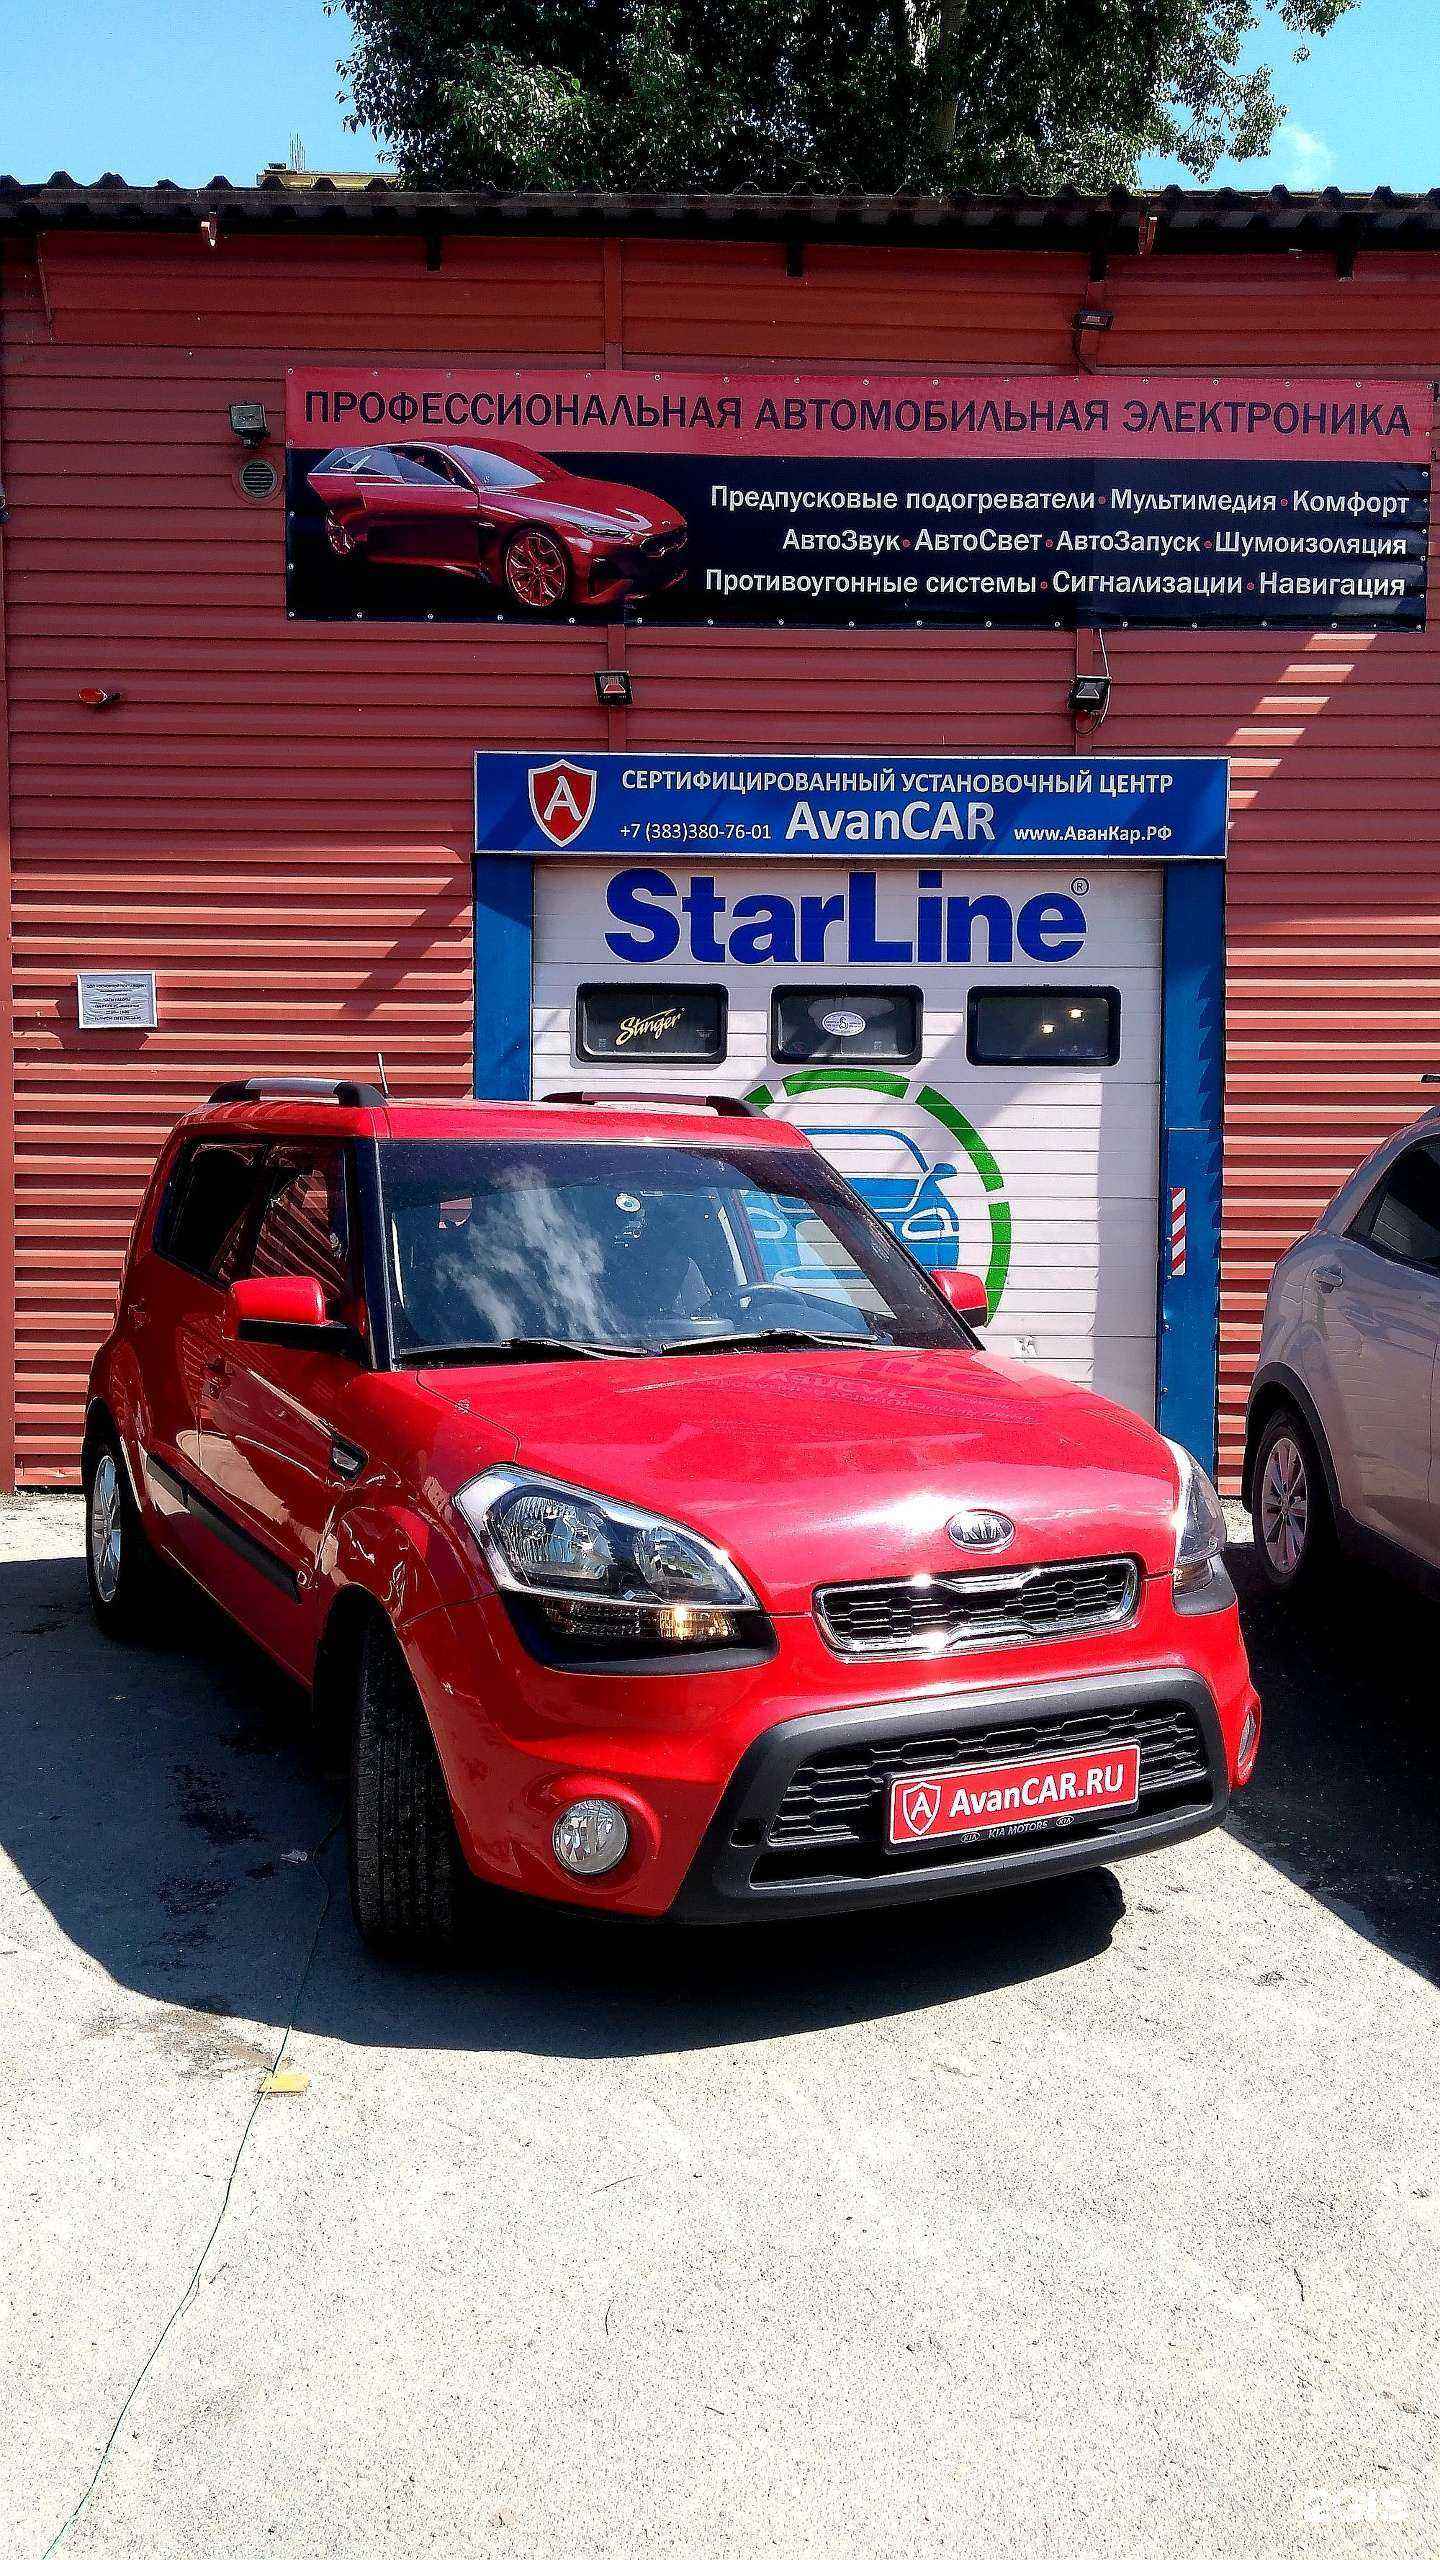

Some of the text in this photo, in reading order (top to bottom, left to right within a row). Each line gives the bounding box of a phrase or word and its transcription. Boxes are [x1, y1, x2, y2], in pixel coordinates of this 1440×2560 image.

[305, 390, 1411, 436] ПРОФЕССИОНАЛЬНАЯ АВТОМОБИЛЬНАЯ ЭЛЕКТРОНИКА
[711, 485, 1409, 518] Предпусковые подогреватели Мультимедия Комфорт
[782, 528, 1407, 558] АвтоЗвук АвтоСвет АвтоЗапуск Шумоизоляция
[705, 568, 1406, 599] Противоугонные системы Сигнализации Навигация
[622, 767, 1173, 797] СЕРТИФИЦИРОВАННЫЙ УСТАНОВОЧНЫЙ ЦЕНТР
[620, 822, 772, 842] +7 (383)380-76-01
[785, 800, 996, 840] AvanCAR
[1013, 825, 1172, 844] www.АванКар.РФ
[604, 868, 1088, 964] StarLine
[616, 1009, 682, 1045] Stinger
[960, 1518, 1007, 1541] KIA
[949, 1763, 1124, 1818] AvanCAR.RU
[988, 1821, 1048, 1839] KIA MOTORS
